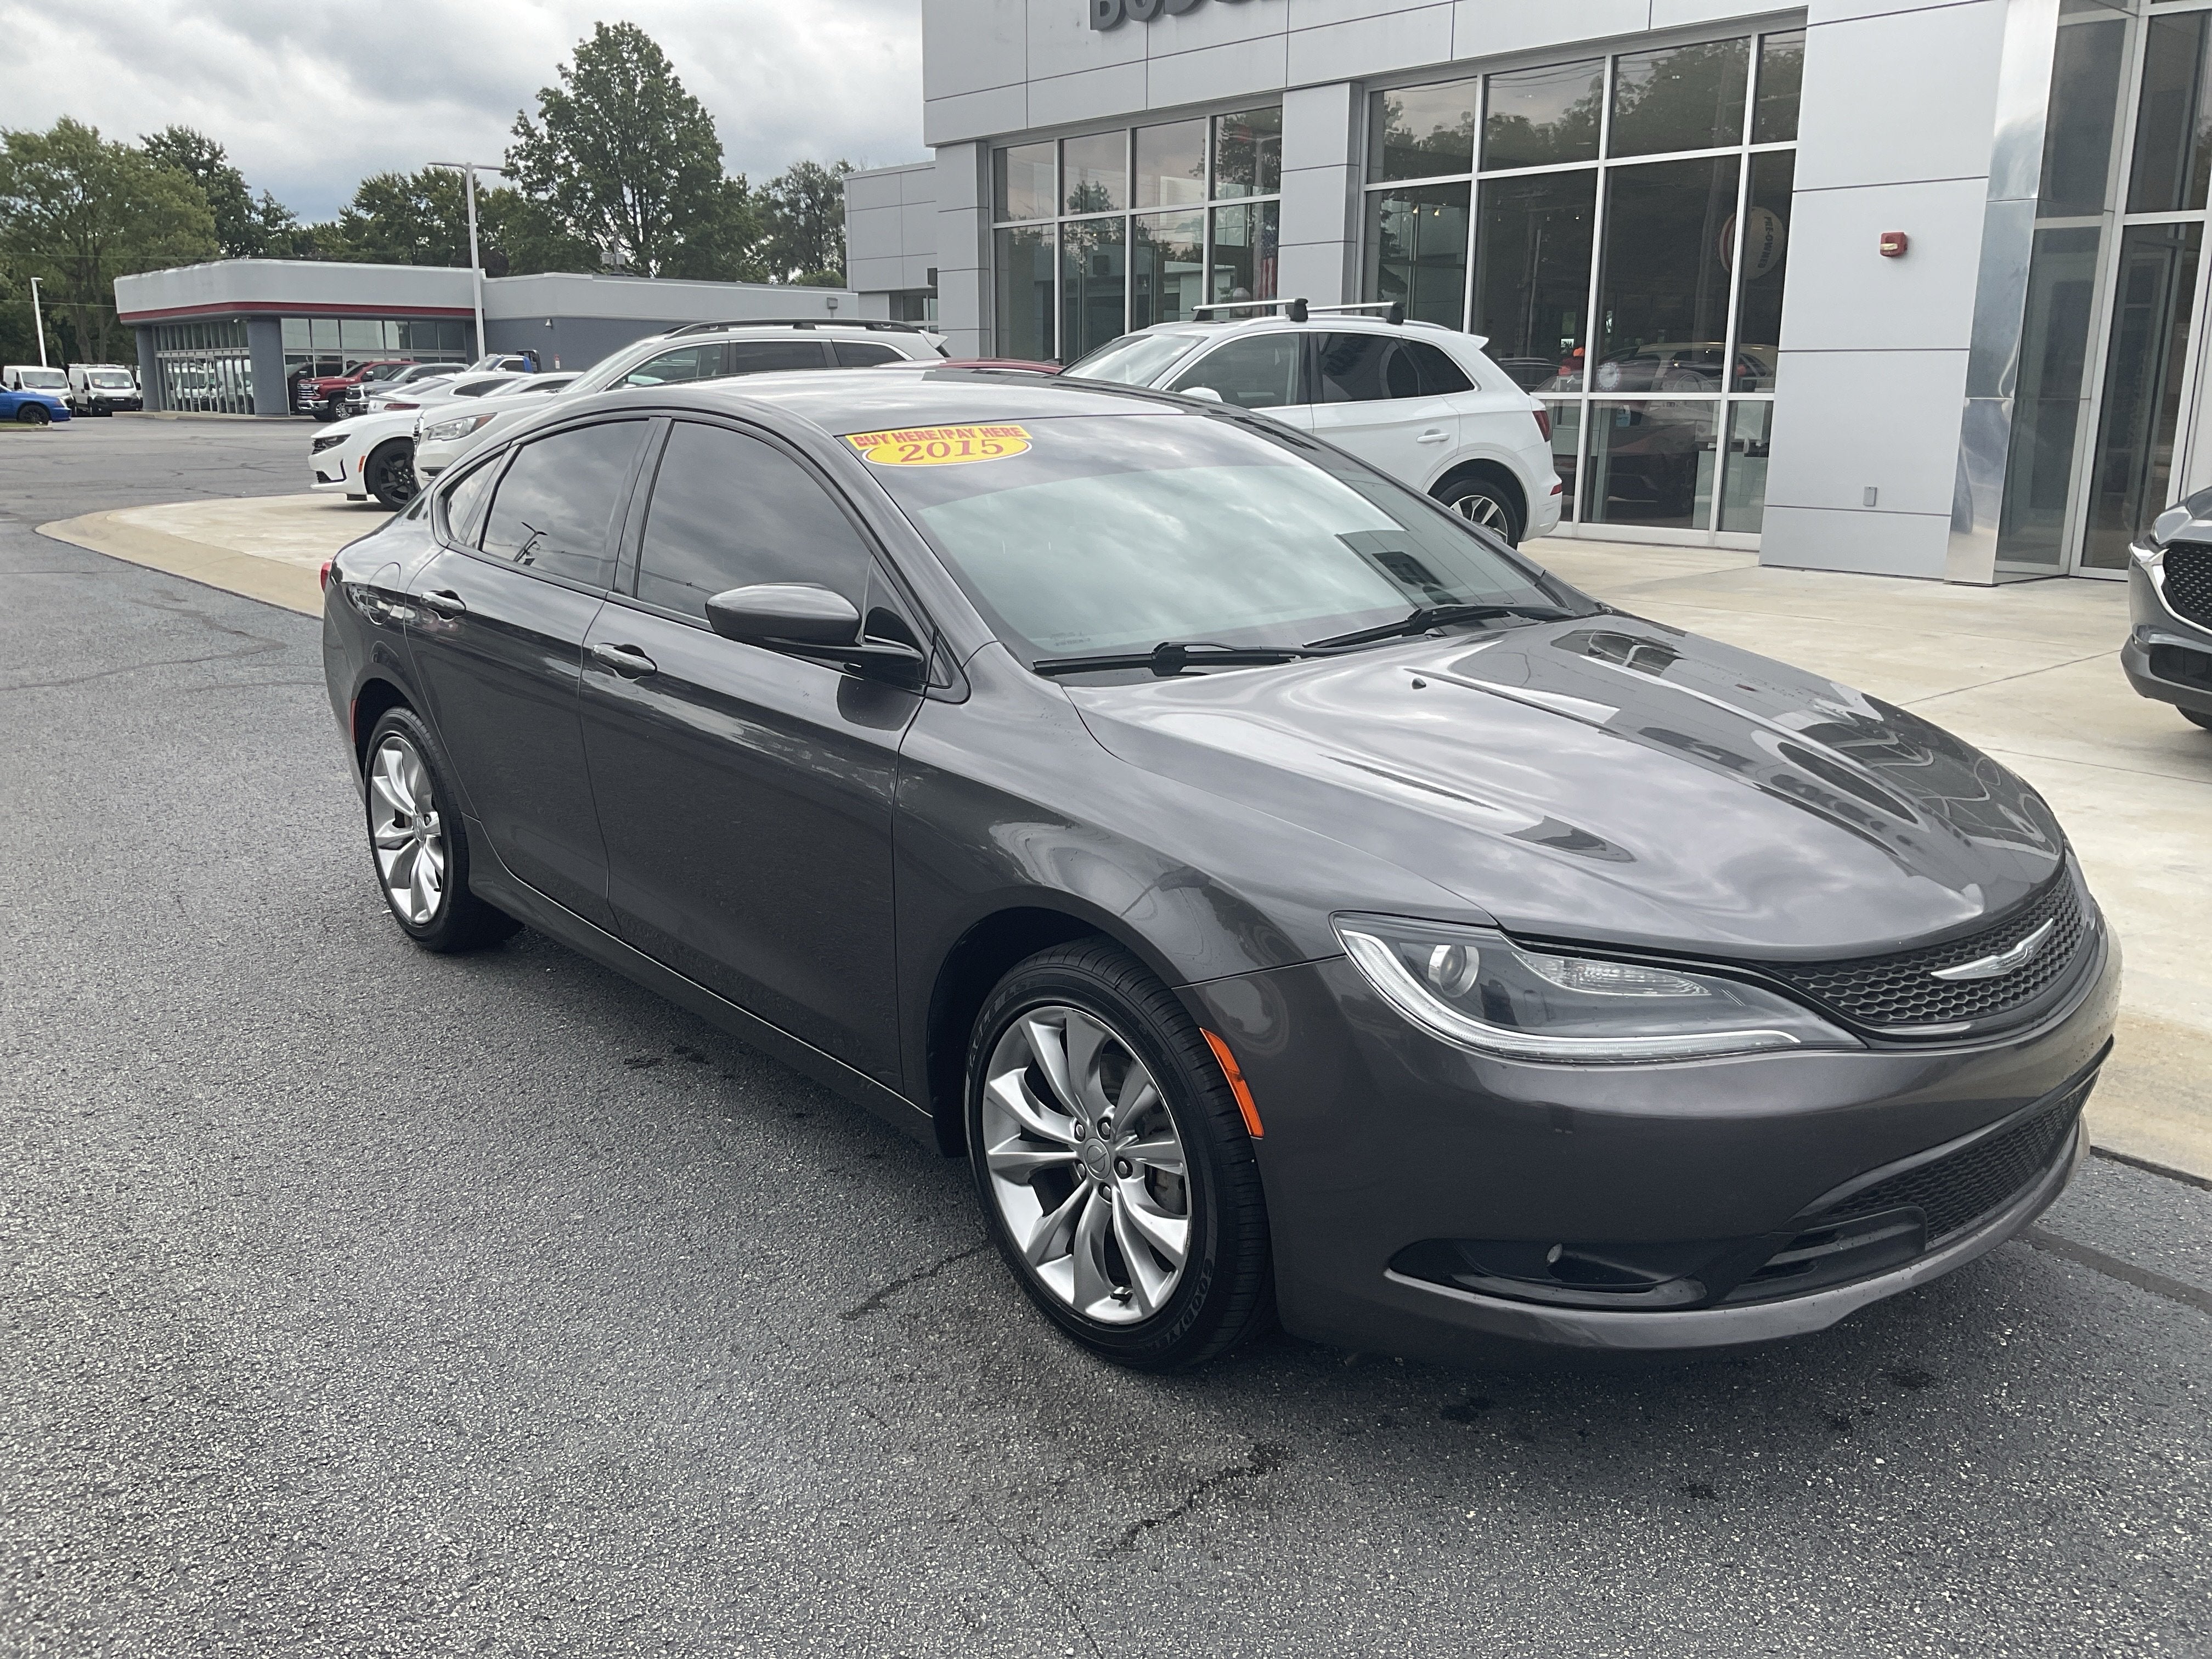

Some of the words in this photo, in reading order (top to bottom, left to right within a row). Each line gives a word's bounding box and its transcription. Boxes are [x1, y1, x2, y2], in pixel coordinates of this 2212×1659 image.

[853, 433, 891, 447] BUY
[891, 428, 978, 443] HERE/PAY
[978, 427, 1027, 438] HERE
[898, 439, 1003, 462] 2015
